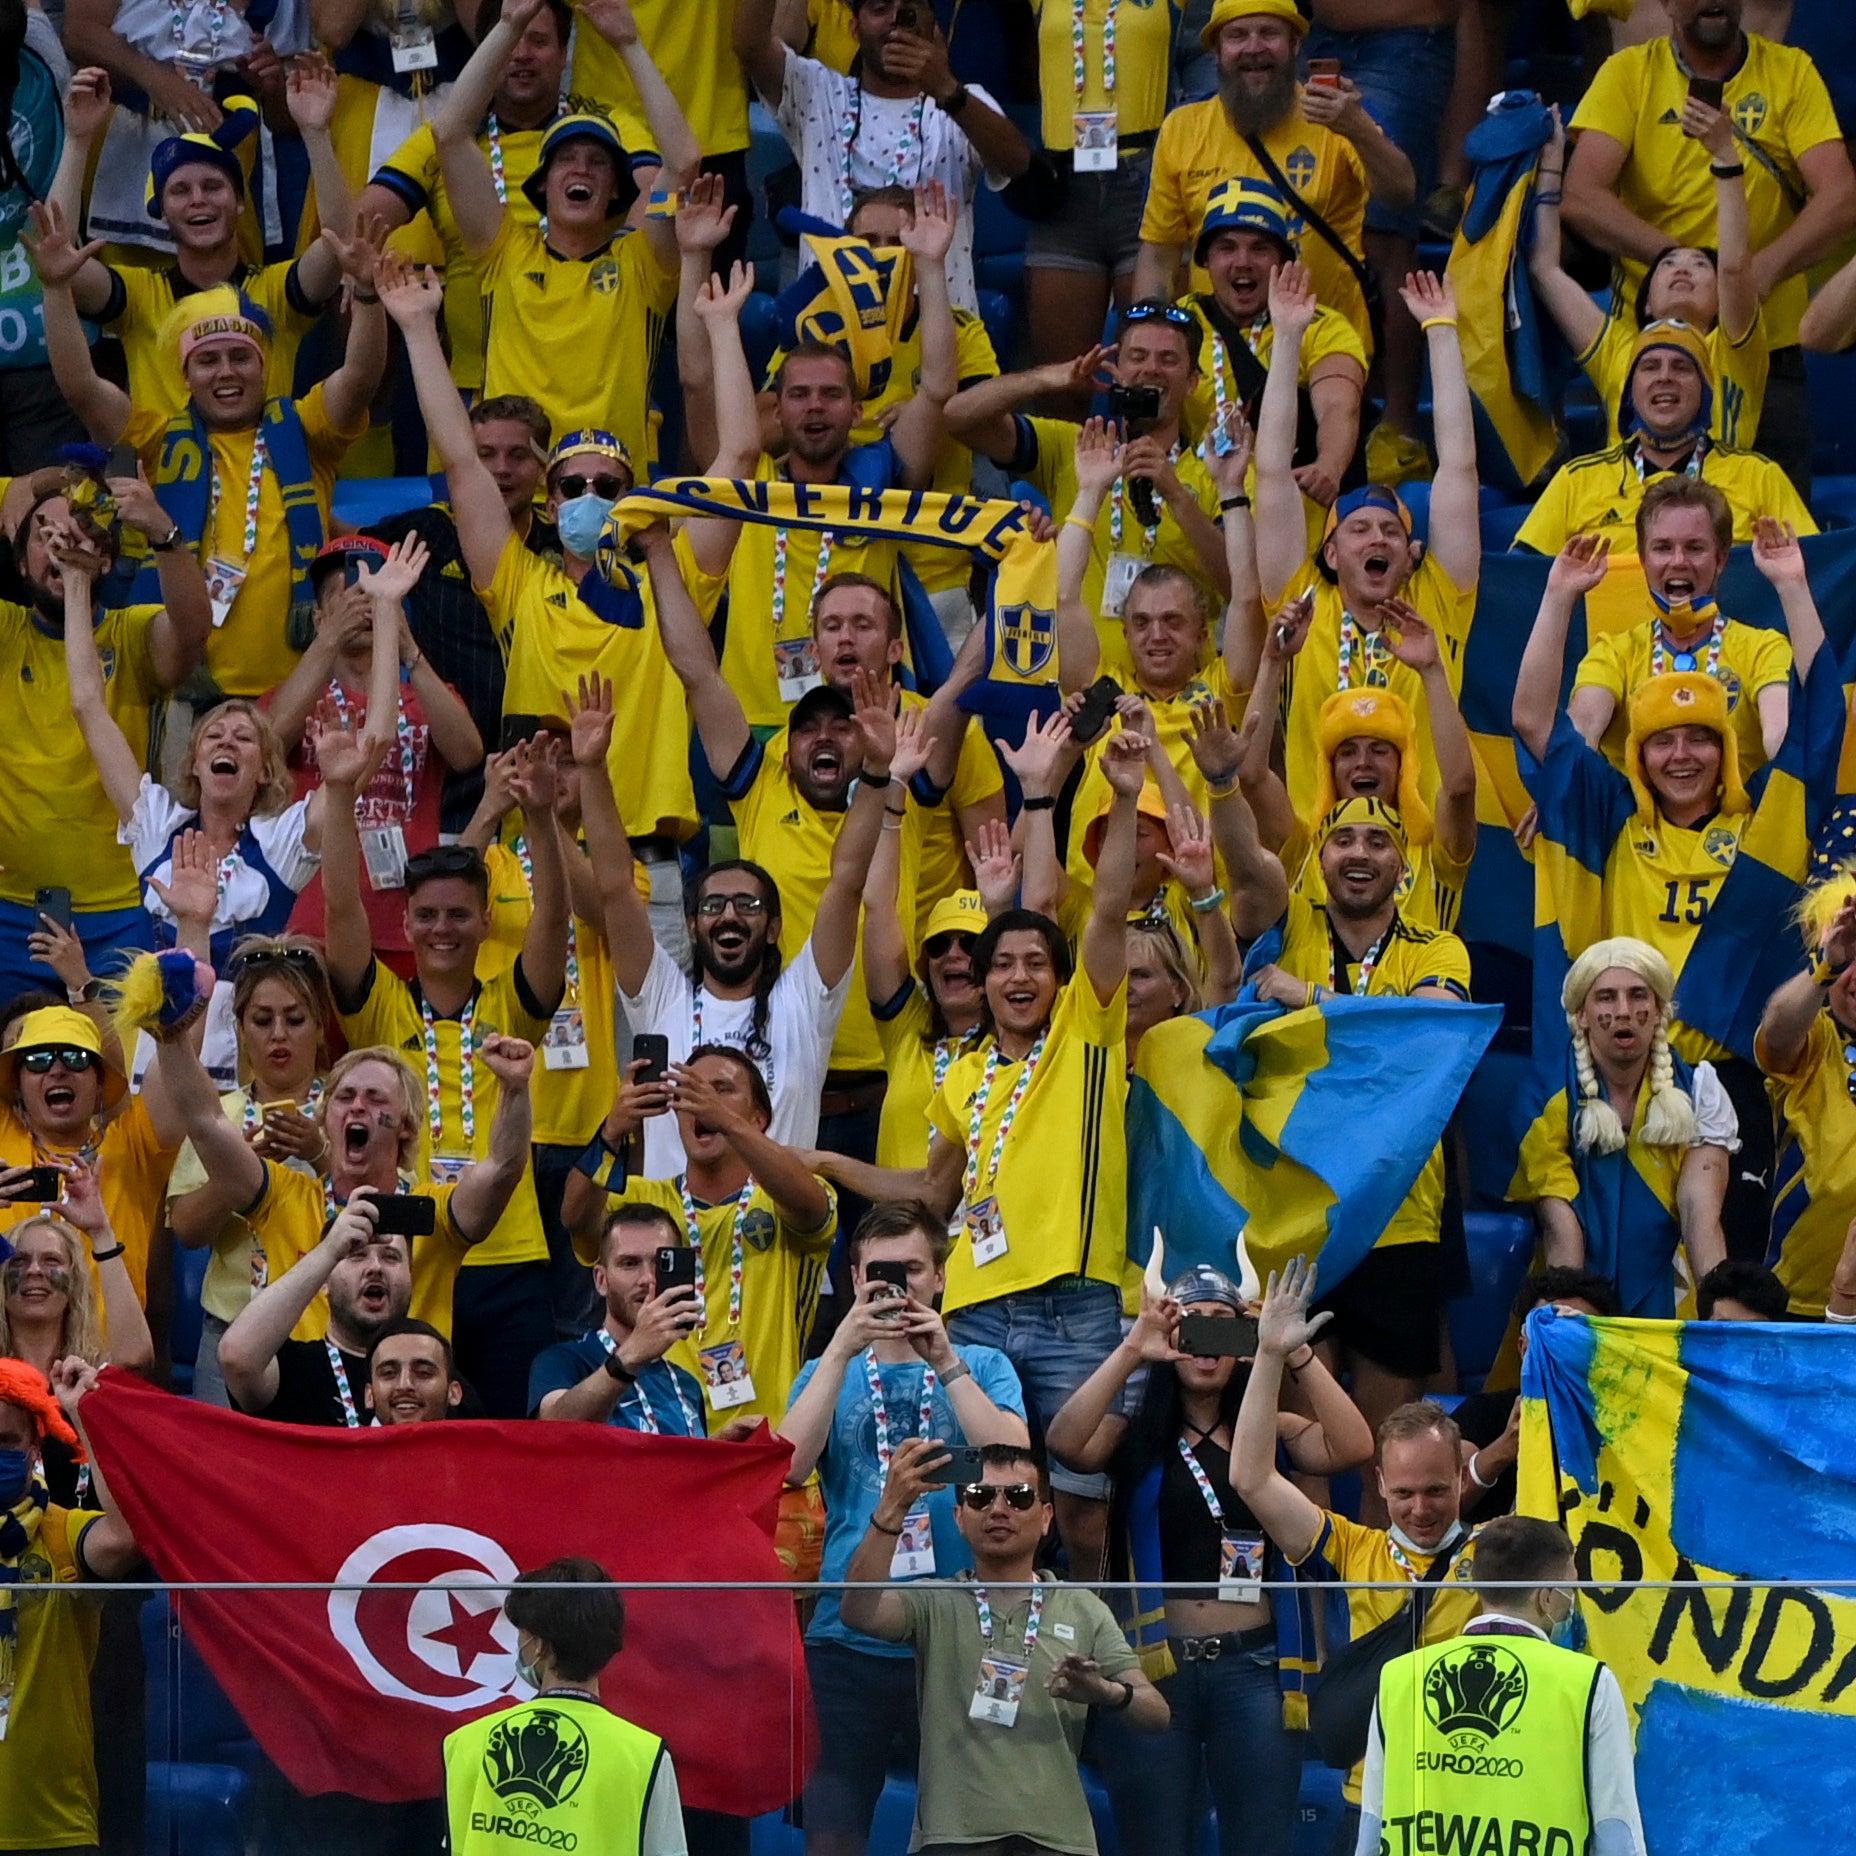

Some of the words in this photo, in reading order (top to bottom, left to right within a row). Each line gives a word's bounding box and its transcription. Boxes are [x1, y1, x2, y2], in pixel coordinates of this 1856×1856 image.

[676, 479, 1031, 554] SVERIGE
[1658, 880, 1709, 925] 15
[1416, 1752, 1523, 1779] EURO2020
[471, 1812, 579, 1852] EURO2020
